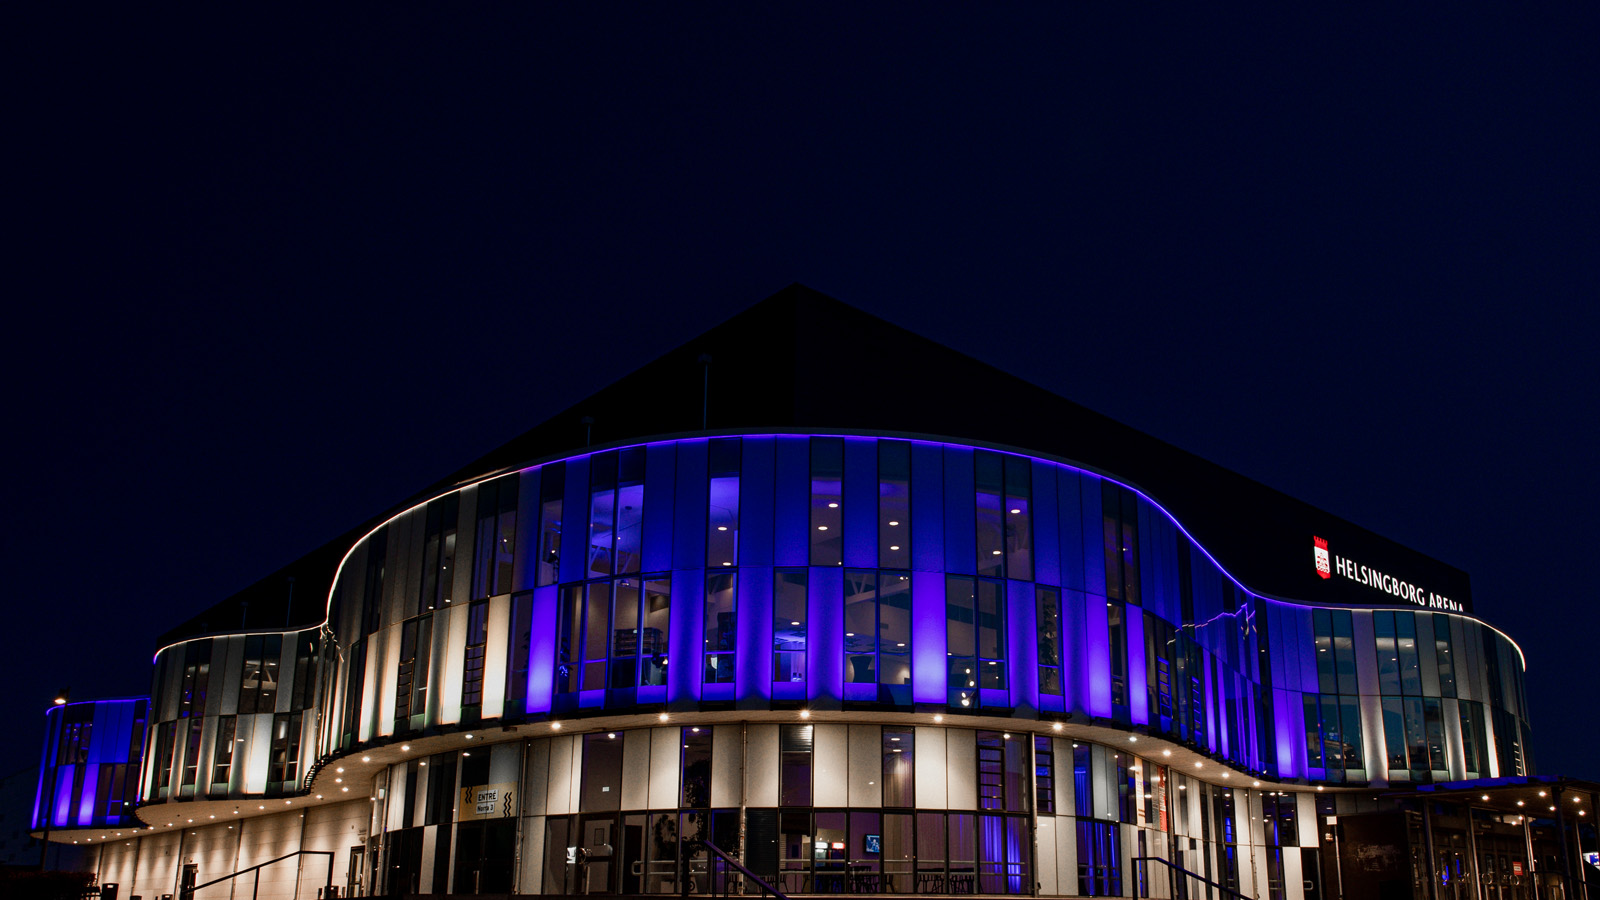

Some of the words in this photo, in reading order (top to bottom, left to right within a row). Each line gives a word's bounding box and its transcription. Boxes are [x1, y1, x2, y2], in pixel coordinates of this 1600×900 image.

[1335, 555, 1425, 606] HELSINGBORG
[1429, 592, 1464, 612] ARENA
[478, 790, 496, 801] ENTRÉ
